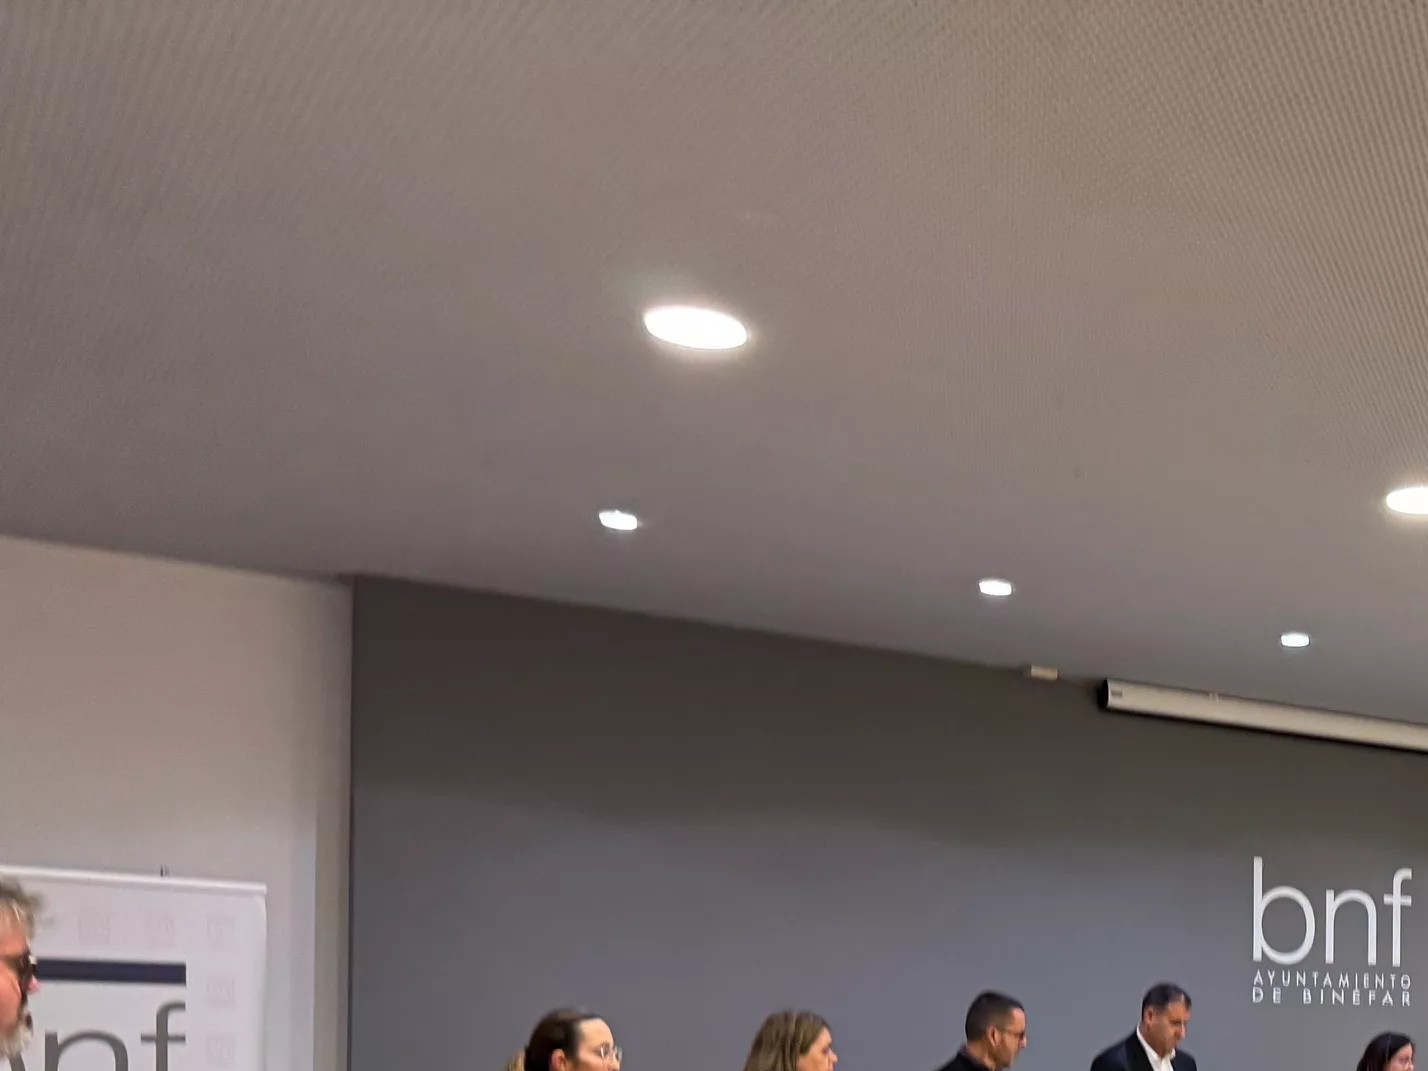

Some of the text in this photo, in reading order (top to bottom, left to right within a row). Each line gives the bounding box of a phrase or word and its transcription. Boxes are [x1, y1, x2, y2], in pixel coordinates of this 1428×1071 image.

[1252, 855, 1413, 968] bnf
[1252, 968, 1412, 990] AYUNTAMIENTO
[1252, 987, 1282, 1004] DE
